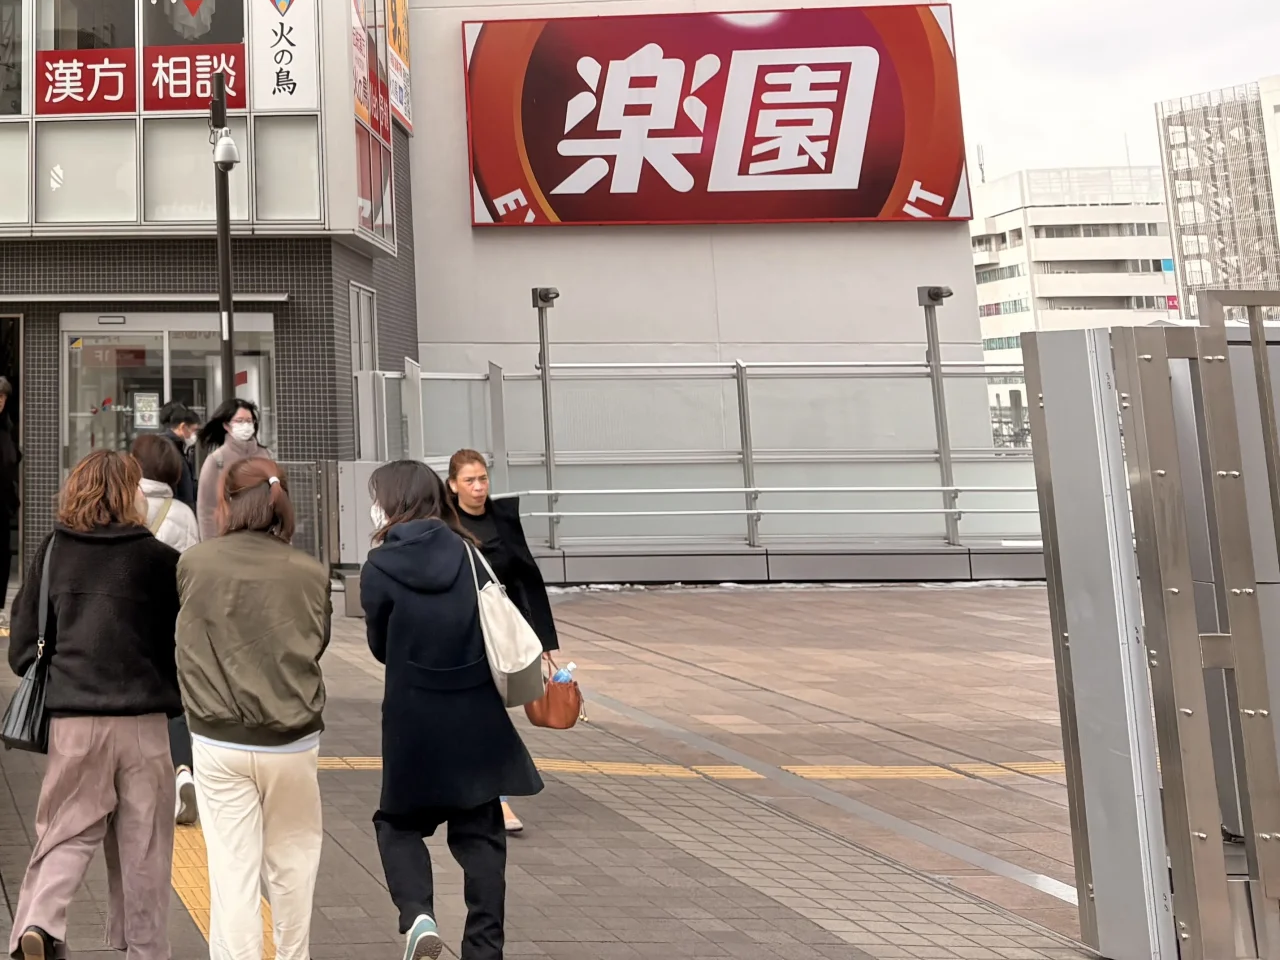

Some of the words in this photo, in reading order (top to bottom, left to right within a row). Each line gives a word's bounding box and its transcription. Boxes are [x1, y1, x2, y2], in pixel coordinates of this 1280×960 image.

[45, 58, 126, 102] 漢方
[151, 53, 237, 99] 相談
[270, 22, 297, 95] 火の鳥
[549, 43, 880, 194] 楽園
